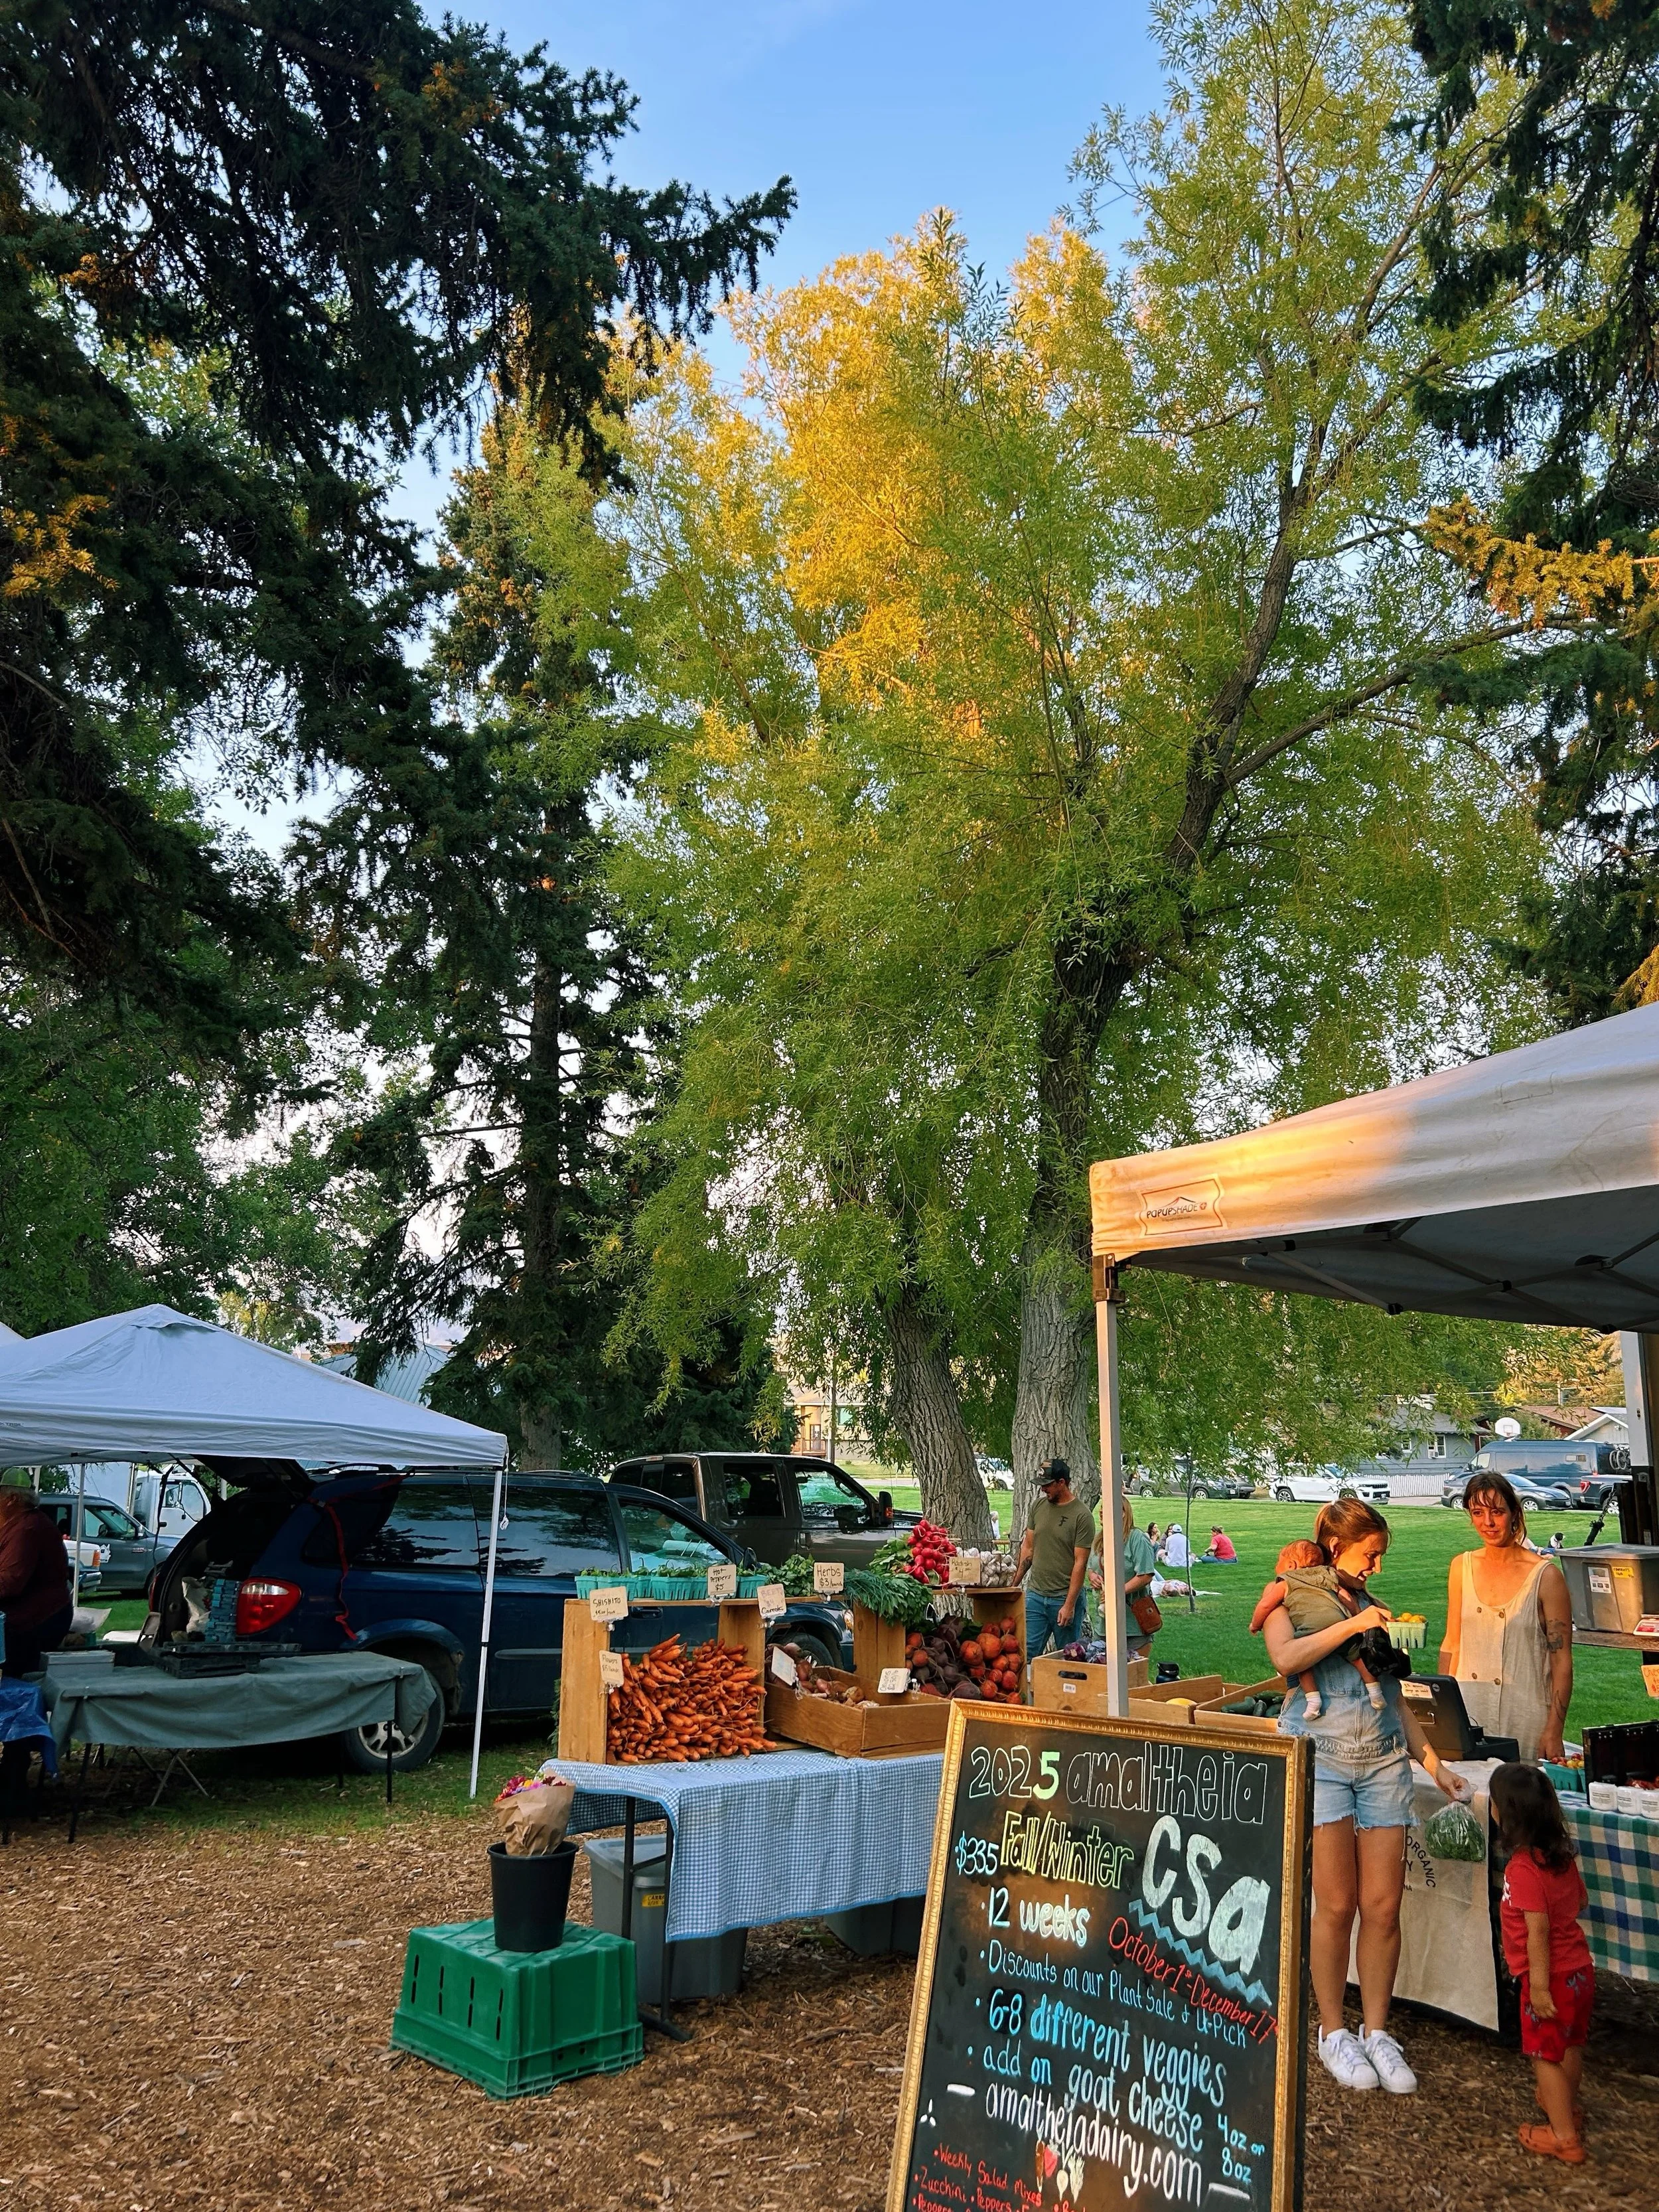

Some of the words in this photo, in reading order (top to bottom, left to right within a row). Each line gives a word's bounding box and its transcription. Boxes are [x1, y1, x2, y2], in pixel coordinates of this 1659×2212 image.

[1146, 1204, 1198, 1218] POPUPSHADE
[593, 1597, 621, 1607] SHISHITO
[817, 1565, 841, 1577] Herbs
[969, 1745, 1060, 1801] 2025
[1066, 1741, 1267, 1825] amaltheia
[1000, 1810, 1135, 1889] Fall/Winter
[1406, 1835, 1437, 1888] ORGANIC
[988, 1886, 1011, 1928] 12
[1019, 1894, 1091, 1949] weeks
[1108, 1916, 1177, 1982] October
[988, 1939, 1058, 1983] Discounts
[1063, 1966, 1078, 1991] on
[1082, 1970, 1104, 1998] our
[1110, 1969, 1143, 2009] Plant
[1146, 1984, 1175, 2022] Sale
[989, 1988, 1023, 2035] 6-8
[1030, 1992, 1131, 2073] different
[1143, 2034, 1227, 2112] veggies
[983, 2038, 1021, 2077] add
[1031, 2056, 1052, 2085] on
[1063, 2063, 1120, 2118] goat
[1128, 2075, 1203, 2152] cheese
[977, 2160, 1008, 2190] Salad
[985, 2081, 1202, 2208] amaltheiadairy.com
[920, 2165, 967, 2204] Zucchini
